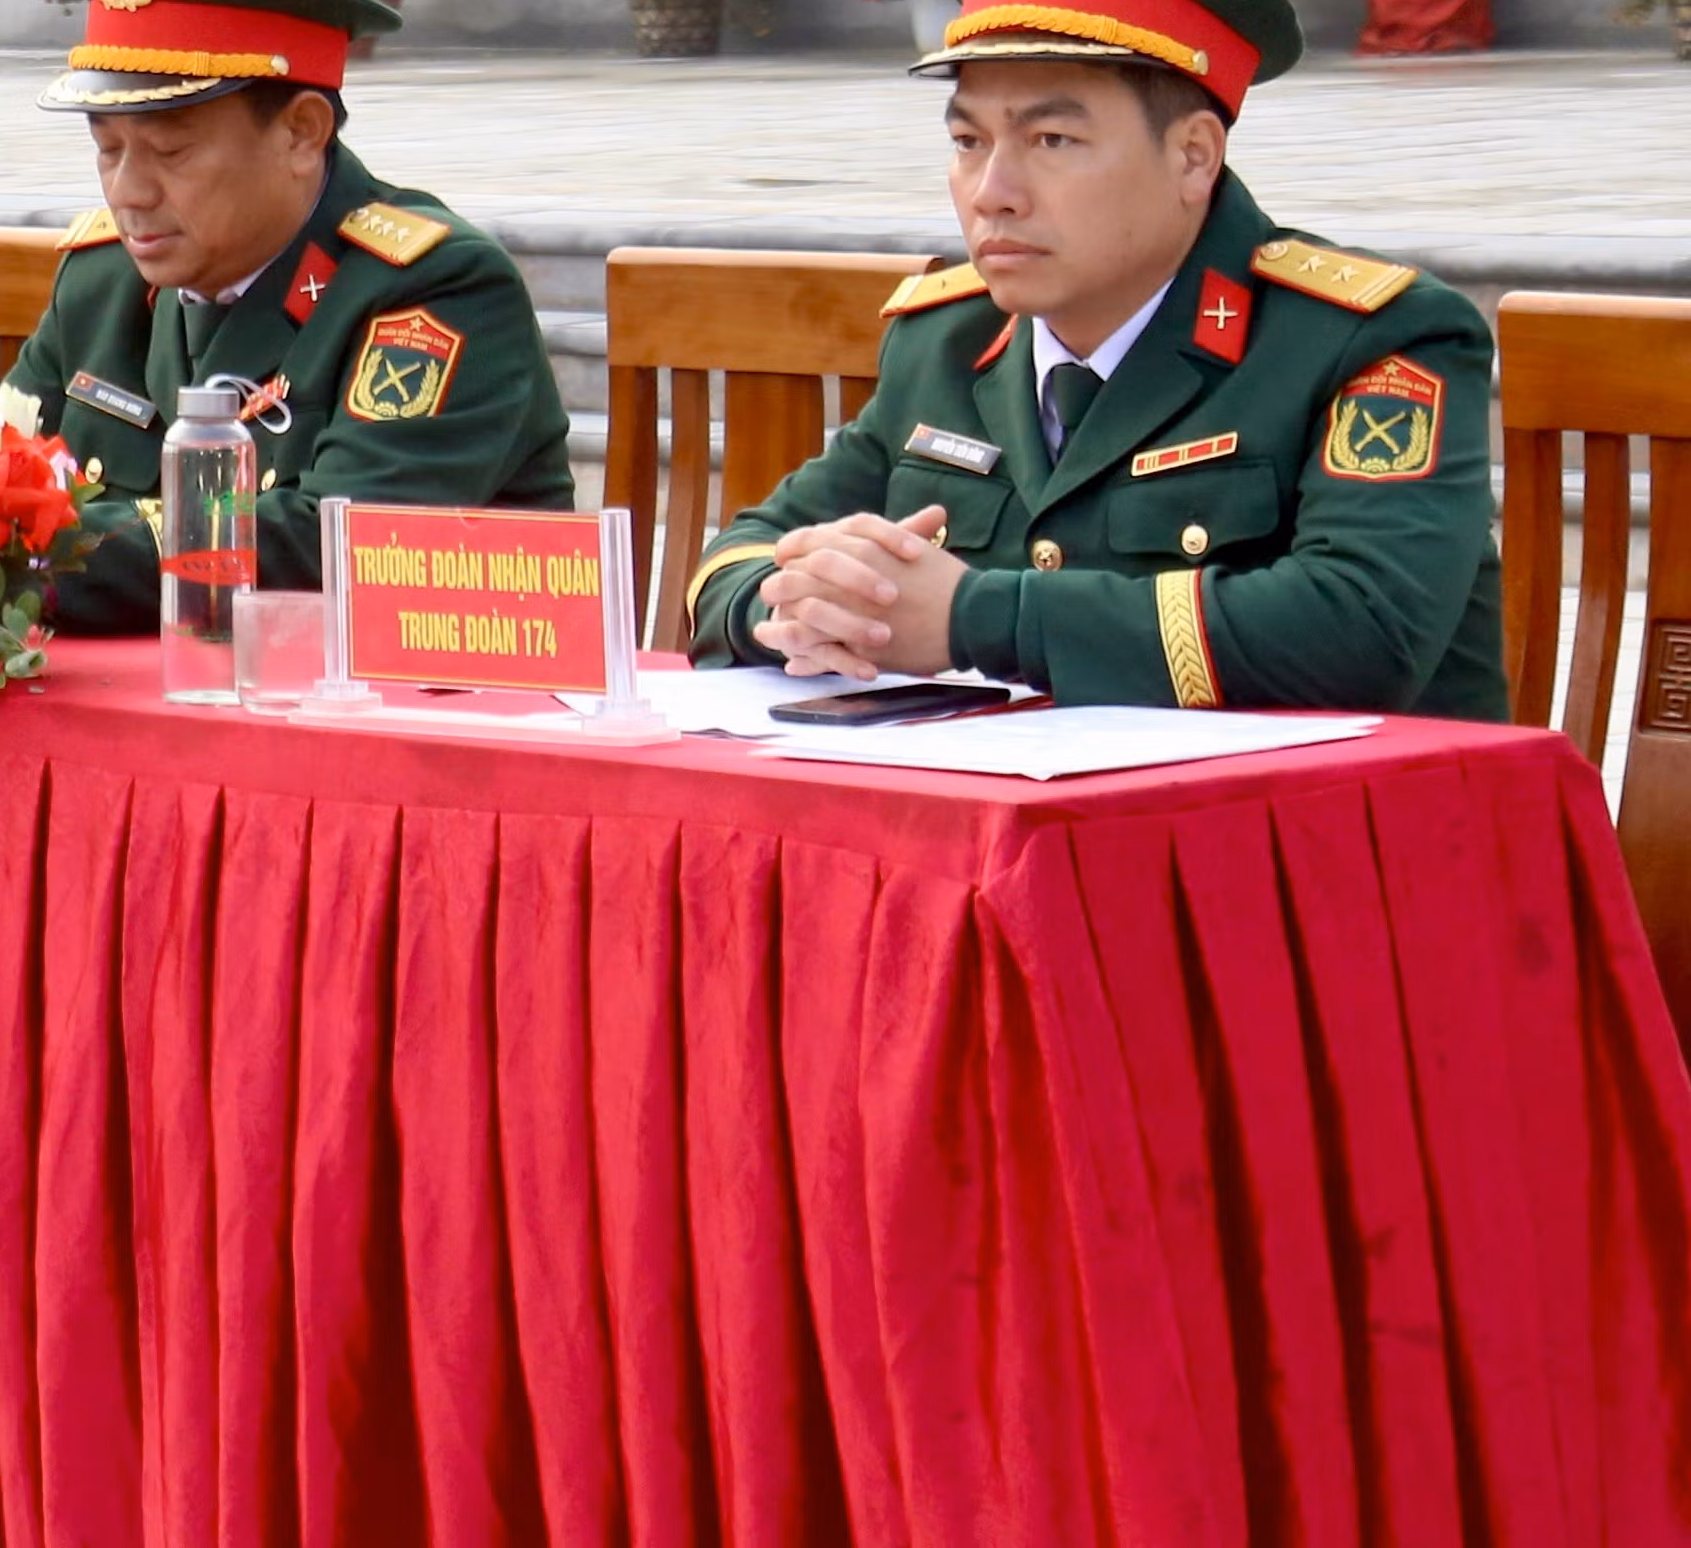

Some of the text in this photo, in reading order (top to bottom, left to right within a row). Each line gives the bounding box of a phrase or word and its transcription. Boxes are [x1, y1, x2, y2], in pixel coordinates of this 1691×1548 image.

[352, 532, 601, 603] TRƯỞNG ĐOÀN NHẬN QUÂN
[398, 607, 558, 659] TRUNG ĐOÀN 174
